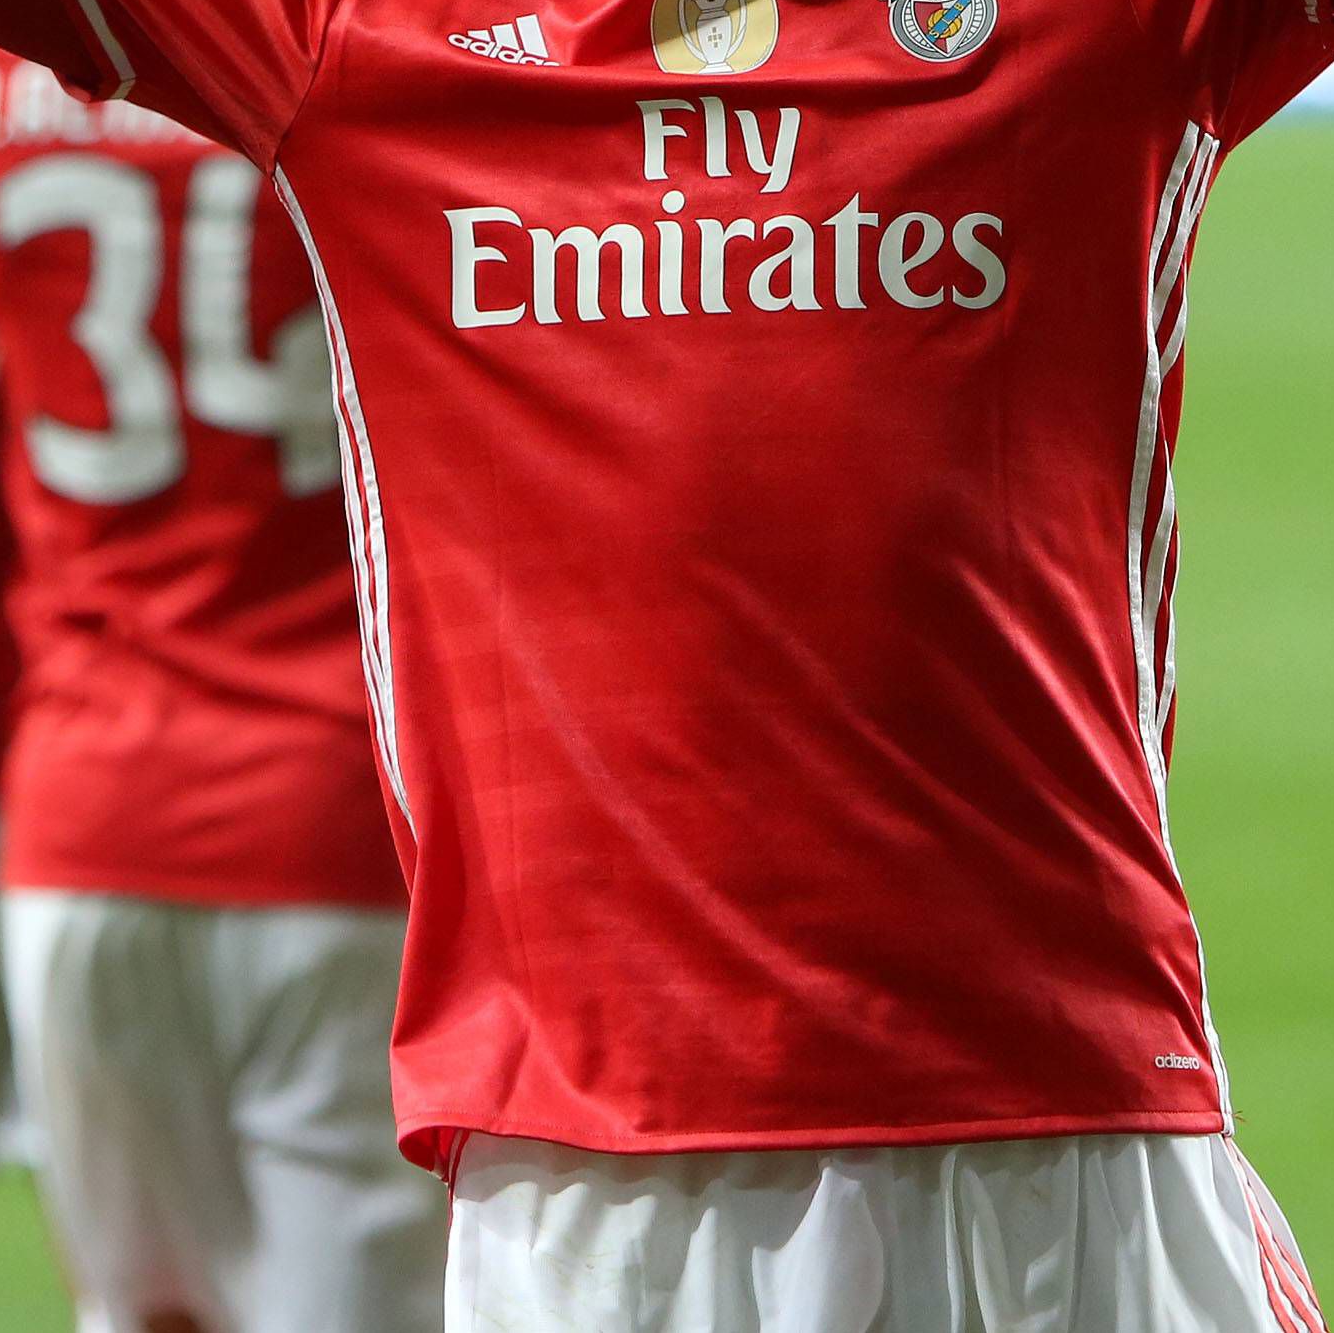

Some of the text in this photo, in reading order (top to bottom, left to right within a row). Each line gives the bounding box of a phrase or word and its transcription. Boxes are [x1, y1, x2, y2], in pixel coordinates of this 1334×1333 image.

[635, 96, 801, 192] Fly
[443, 190, 1006, 329] Emirates
[1155, 1053, 1200, 1070] adizero
